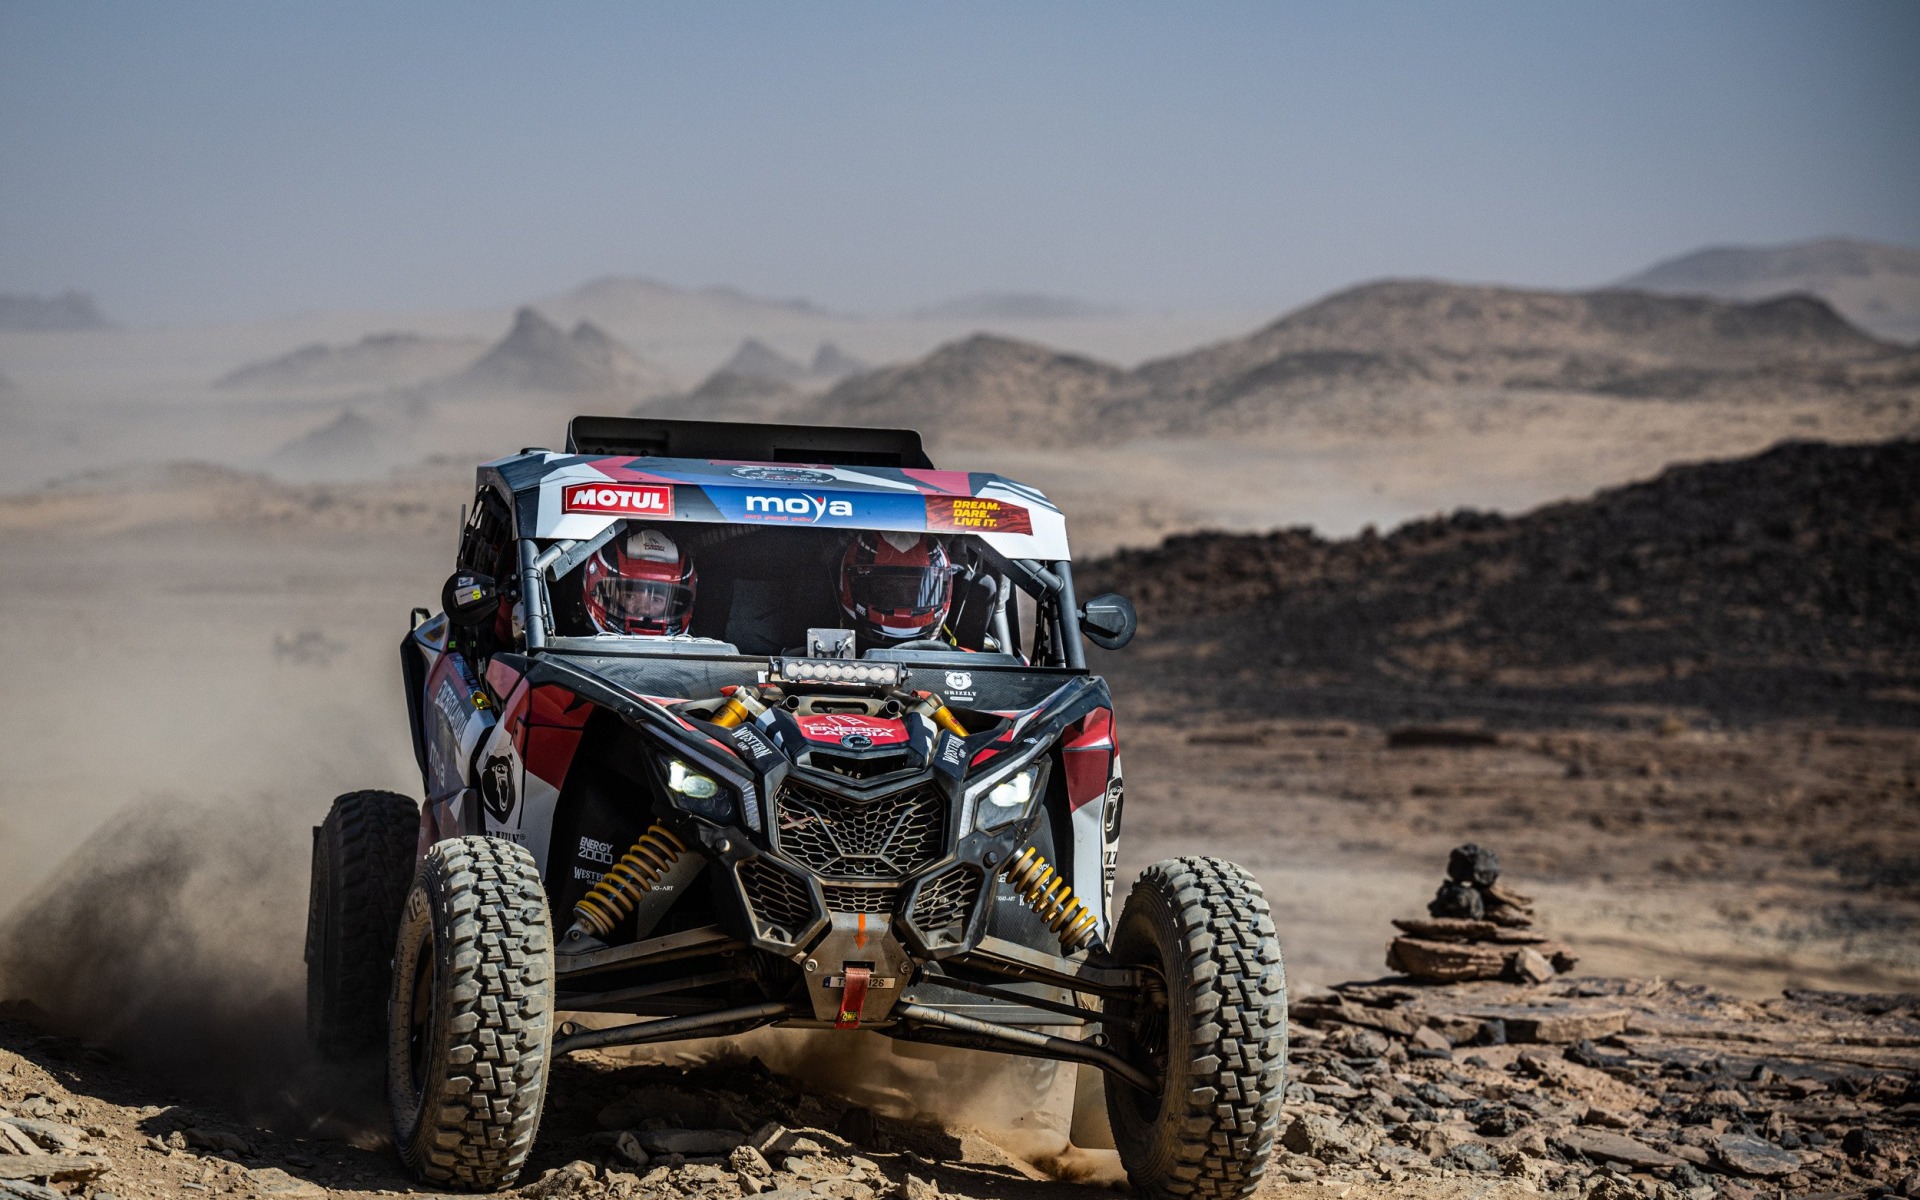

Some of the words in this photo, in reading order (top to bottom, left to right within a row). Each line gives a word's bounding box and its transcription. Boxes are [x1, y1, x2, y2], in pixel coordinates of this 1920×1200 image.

[571, 488, 664, 509] MOTUL
[953, 500, 1001, 510] DREAM.
[746, 492, 853, 524] moya
[953, 509, 990, 518] DARE.
[954, 518, 981, 527] LIVE
[983, 518, 998, 527] IT.
[808, 726, 896, 734] ENERGY
[732, 726, 773, 759] WESTERN
[942, 734, 965, 765] WESTERN
[580, 836, 613, 853] ENERGY
[578, 847, 613, 865] 2000
[574, 866, 611, 882] WESTER
